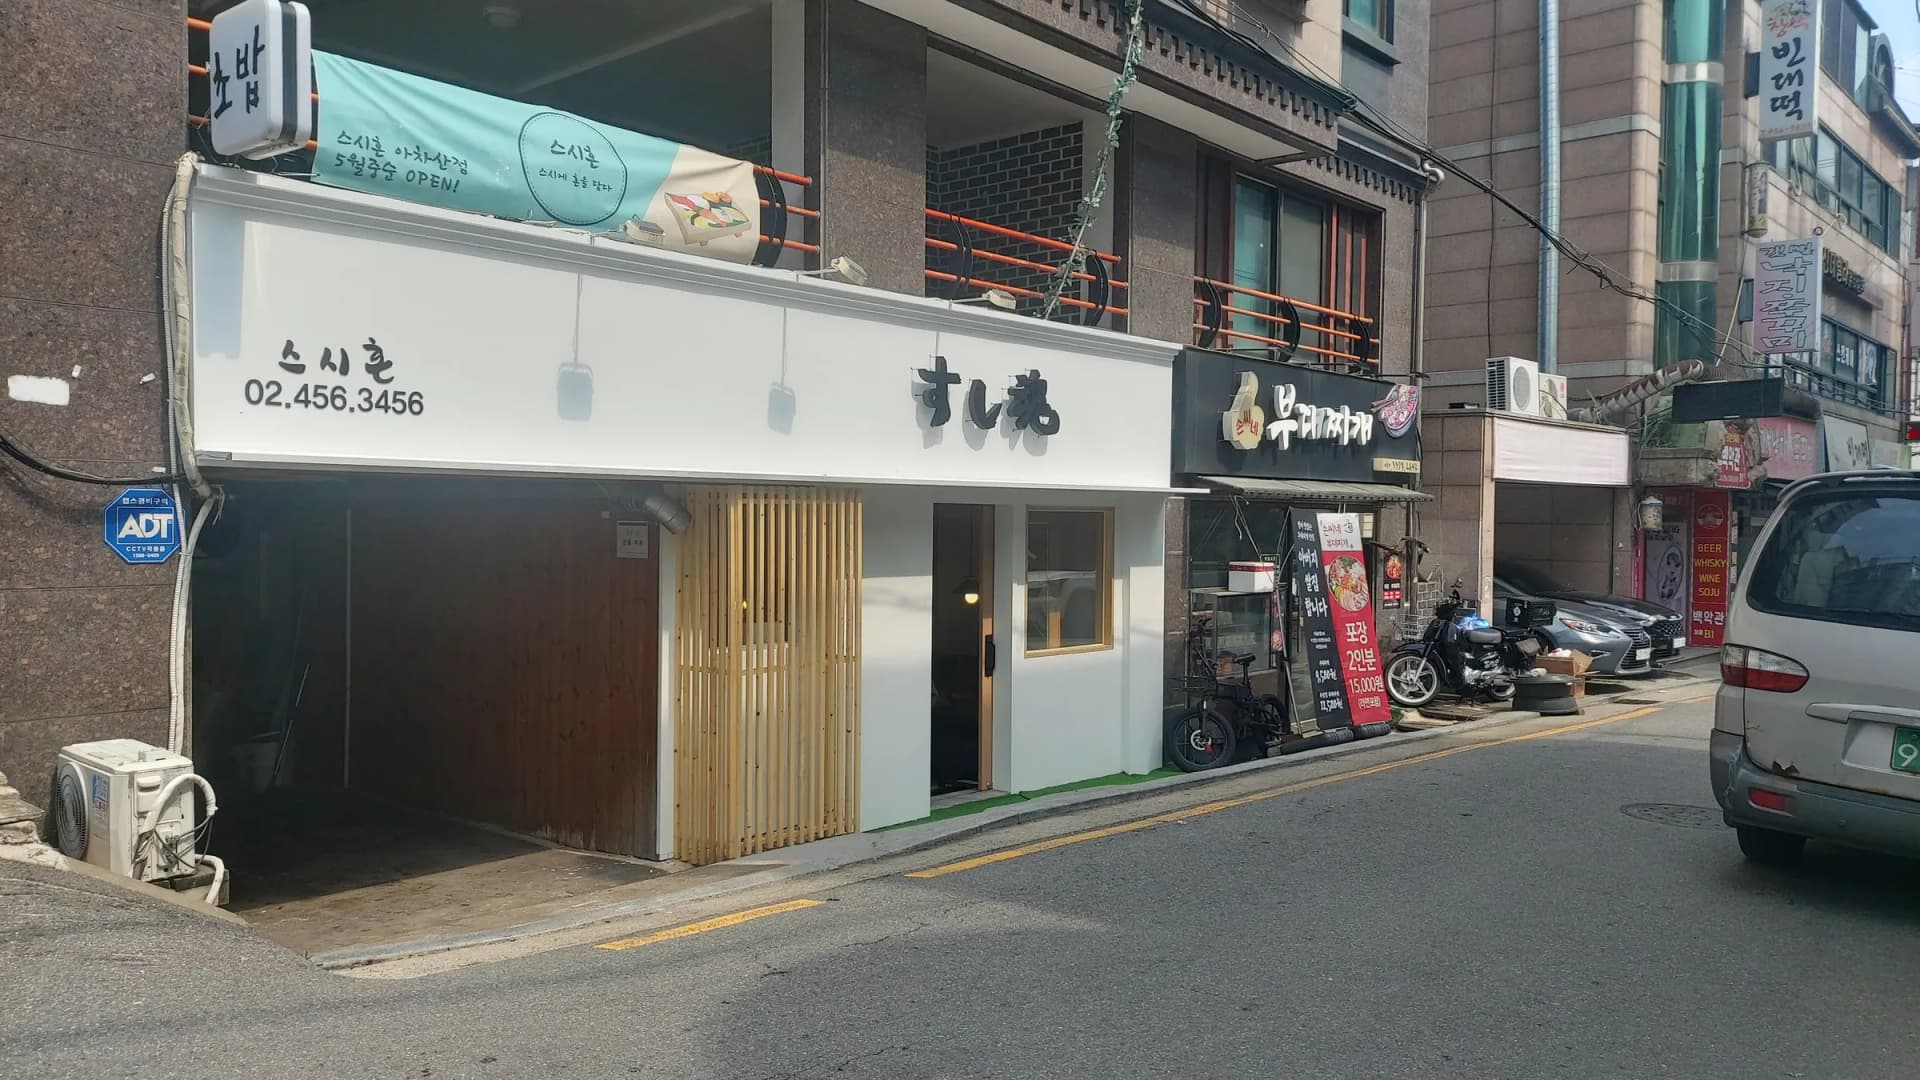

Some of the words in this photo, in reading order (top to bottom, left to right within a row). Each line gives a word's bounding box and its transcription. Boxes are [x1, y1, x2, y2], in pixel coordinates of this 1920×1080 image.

[213, 24, 265, 119] 초밥
[1770, 37, 1806, 120] 빈대떡
[337, 130, 386, 158] 스시혼
[395, 145, 468, 175] 아차산점
[550, 139, 600, 169] 스시혼
[335, 152, 397, 181] 5월중순
[406, 169, 460, 193] OPEN!
[539, 168, 567, 181] 스시에
[592, 180, 612, 192] 담다
[278, 337, 395, 385] 스시혼
[244, 379, 424, 416] 02.456.3456
[1266, 384, 1373, 450] 부대찌개
[117, 513, 174, 538] ADT
[1697, 543, 1722, 553] BEER
[1694, 559, 1726, 568] WHISKY
[1698, 574, 1721, 583] WINE
[1698, 587, 1720, 597] SOJU
[1304, 596, 1328, 618] 합니다
[1692, 610, 1725, 625] 백악관
[1345, 621, 1368, 644] 포장
[1346, 648, 1376, 672] 2인분
[1349, 675, 1385, 694] 15,000원
